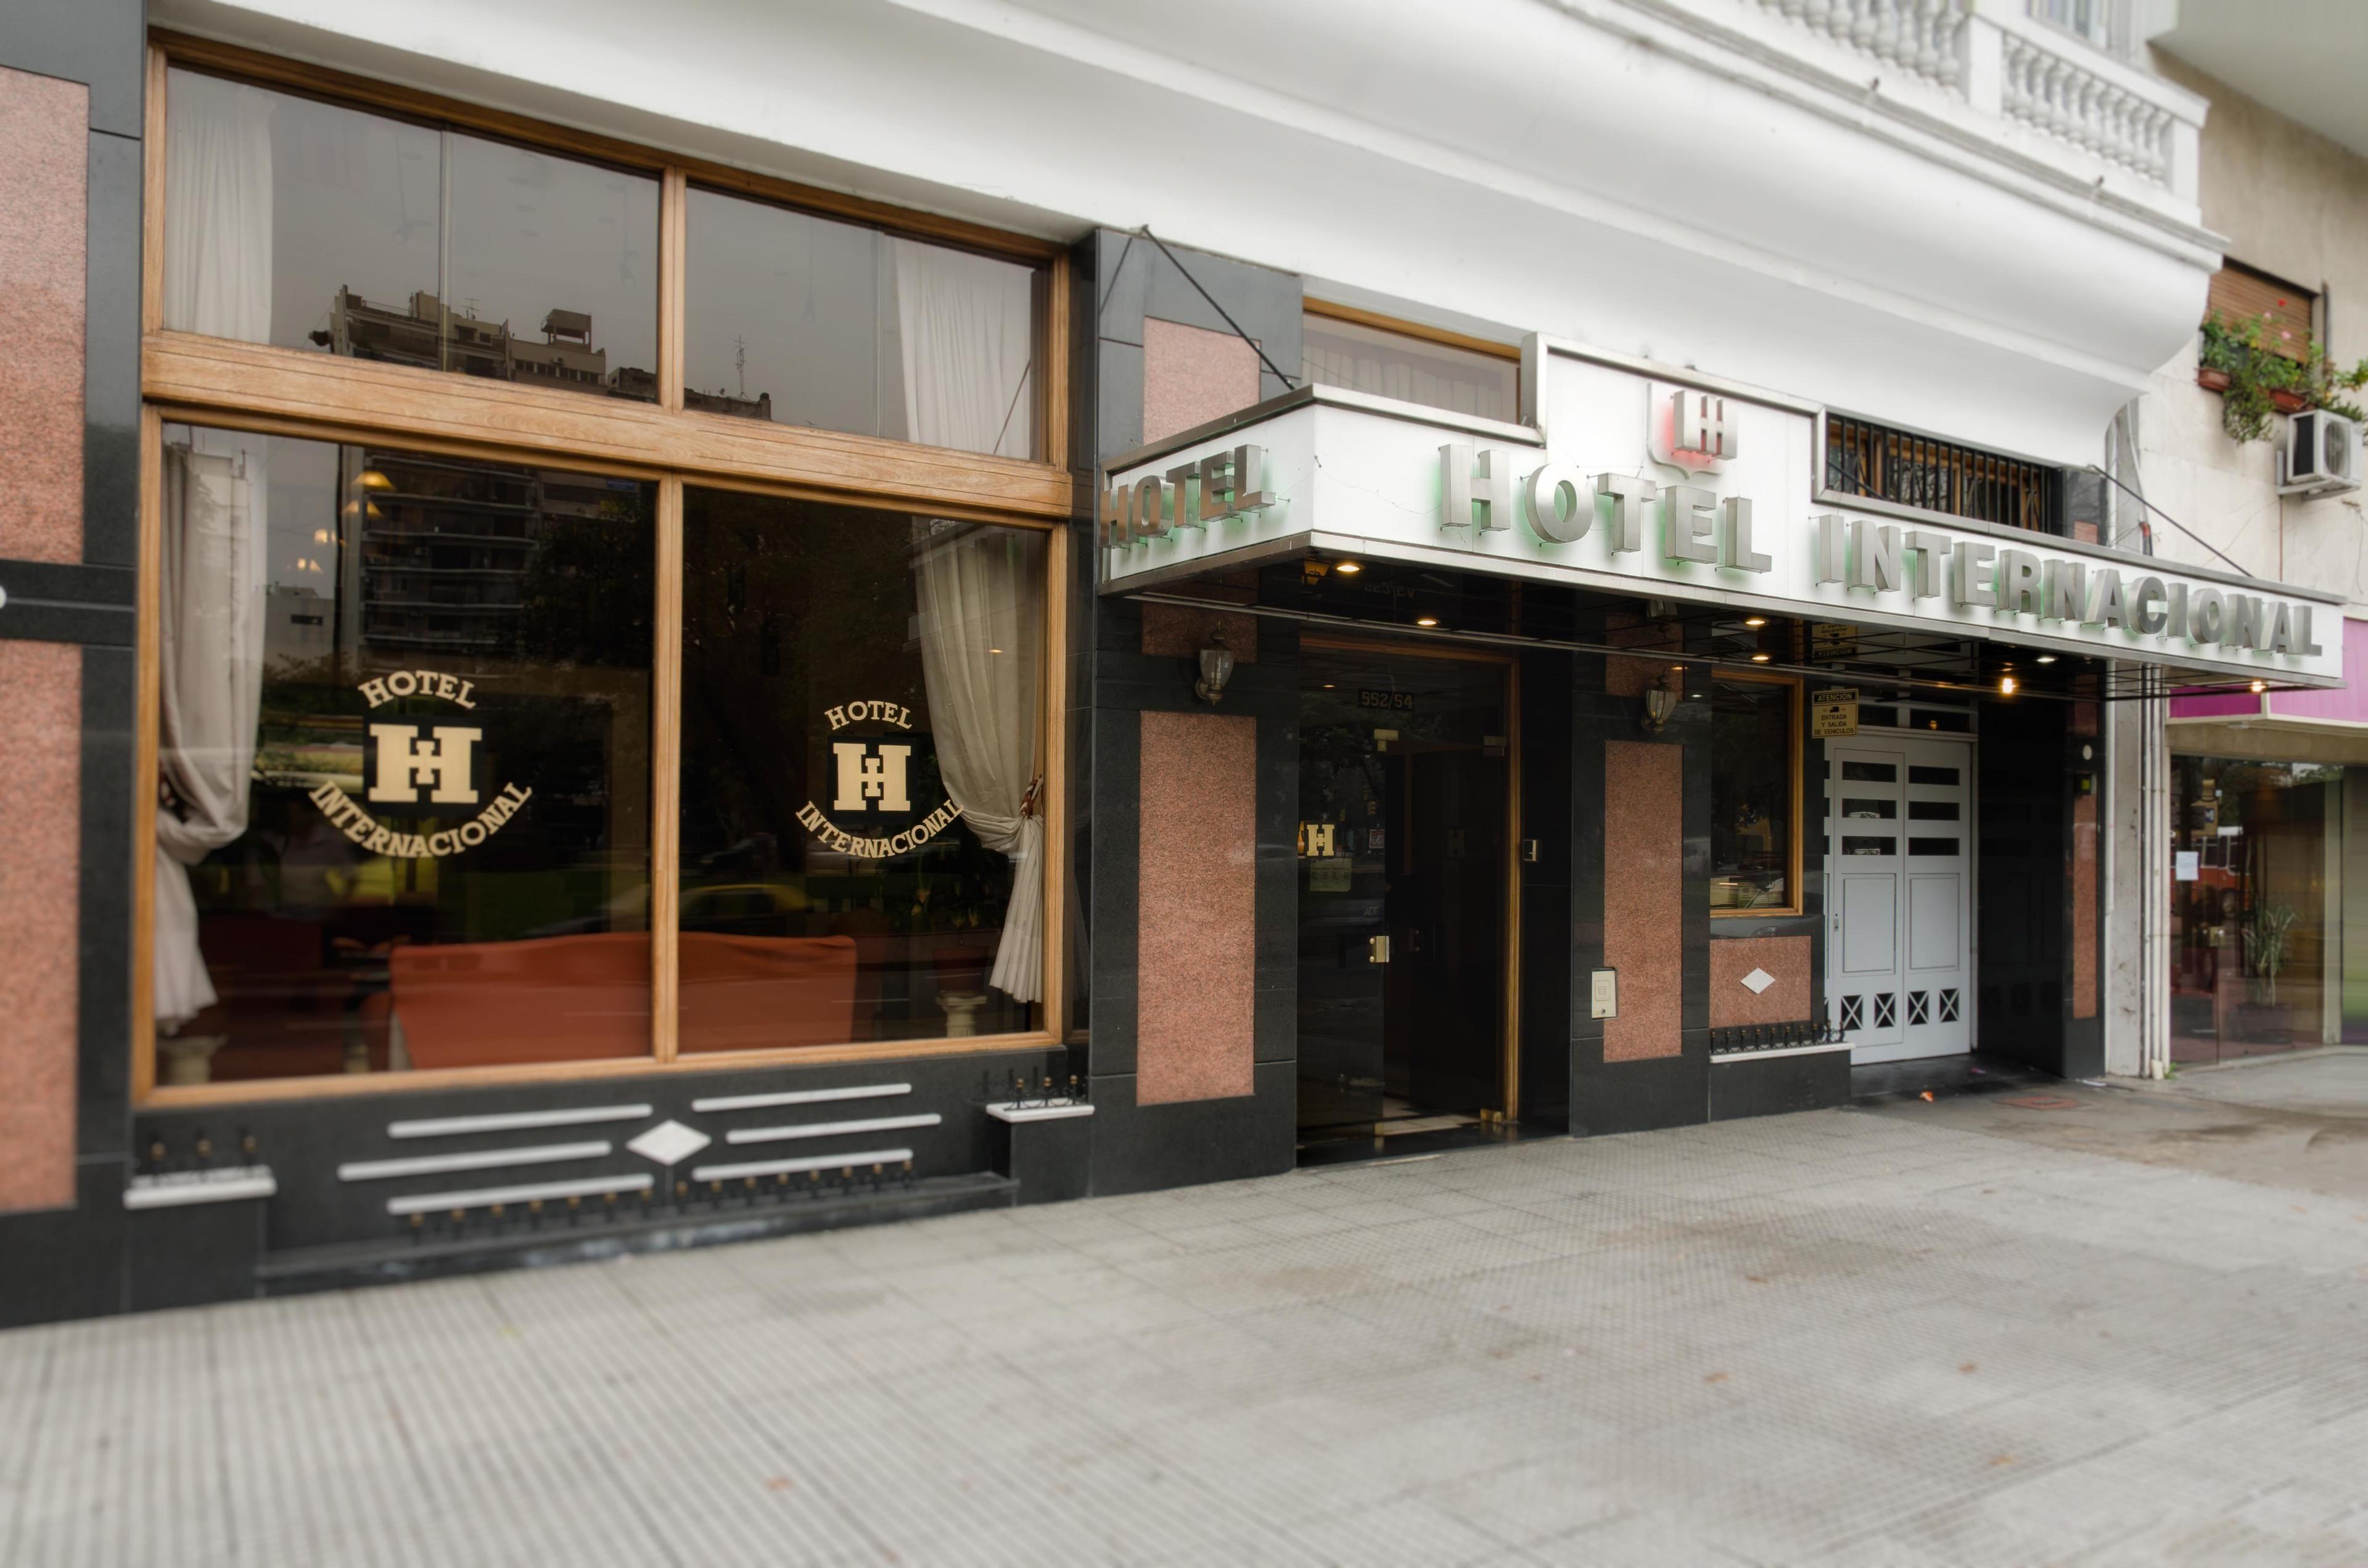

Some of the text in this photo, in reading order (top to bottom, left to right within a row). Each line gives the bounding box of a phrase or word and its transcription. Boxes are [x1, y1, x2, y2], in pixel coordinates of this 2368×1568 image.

[1100, 444, 1276, 547] HOTEL
[1439, 443, 2322, 657] HOTEL INTERNACIONAL
[358, 670, 476, 709] HOTEL
[1362, 691, 1414, 710] 552/54
[1817, 692, 1852, 701] ATENCION
[824, 700, 913, 730] HOTEL
[309, 781, 533, 858] INTERNACIONAL
[796, 800, 964, 858] INTERNACIONAL
[1364, 906, 1379, 916] ADT
